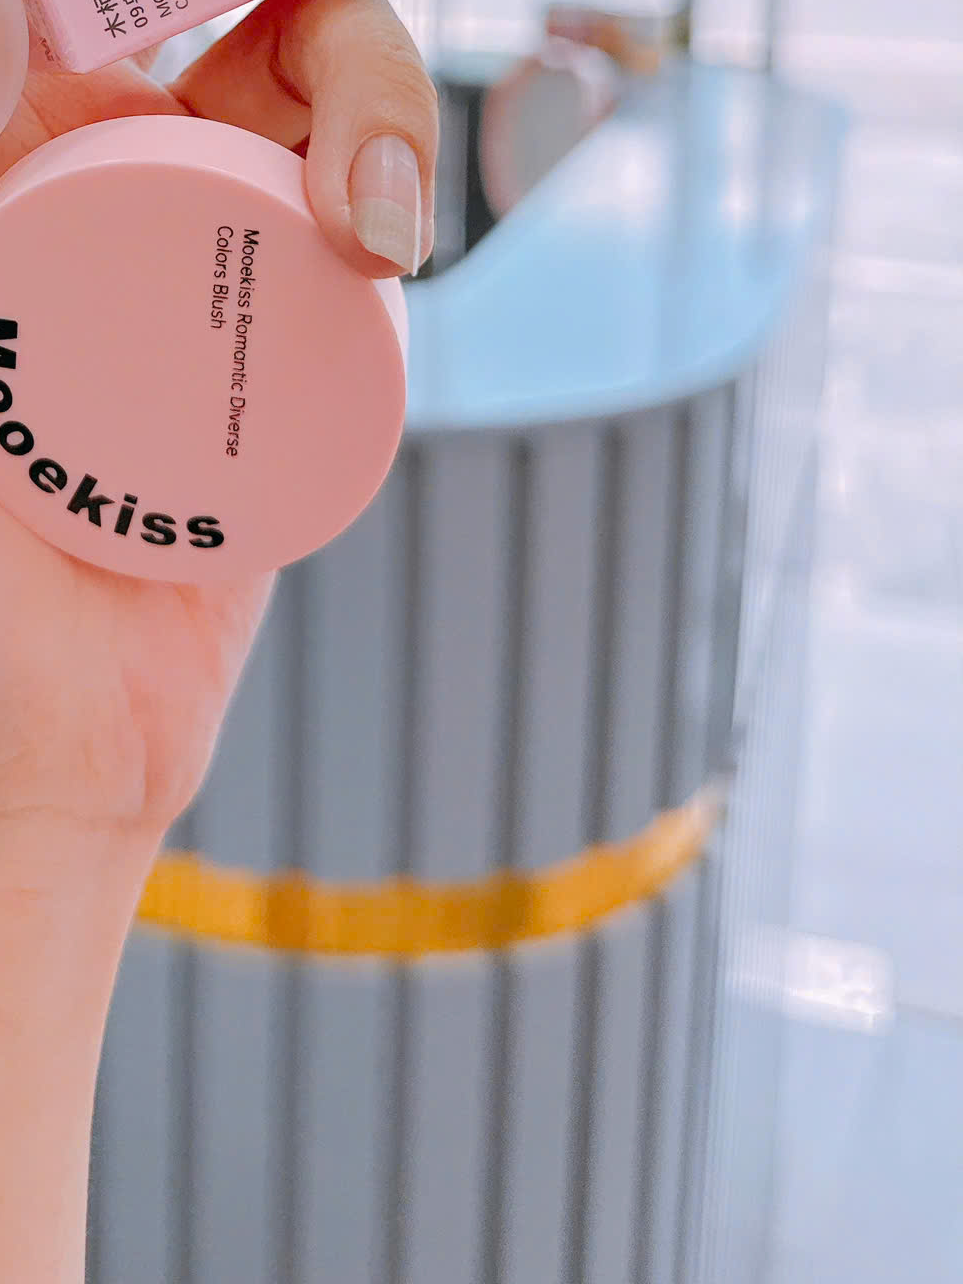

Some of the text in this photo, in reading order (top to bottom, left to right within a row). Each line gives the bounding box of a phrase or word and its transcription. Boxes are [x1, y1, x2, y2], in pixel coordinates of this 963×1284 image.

[210, 225, 234, 329] Colors Blush
[225, 228, 260, 459] Mooekiss Romantic Diverse
